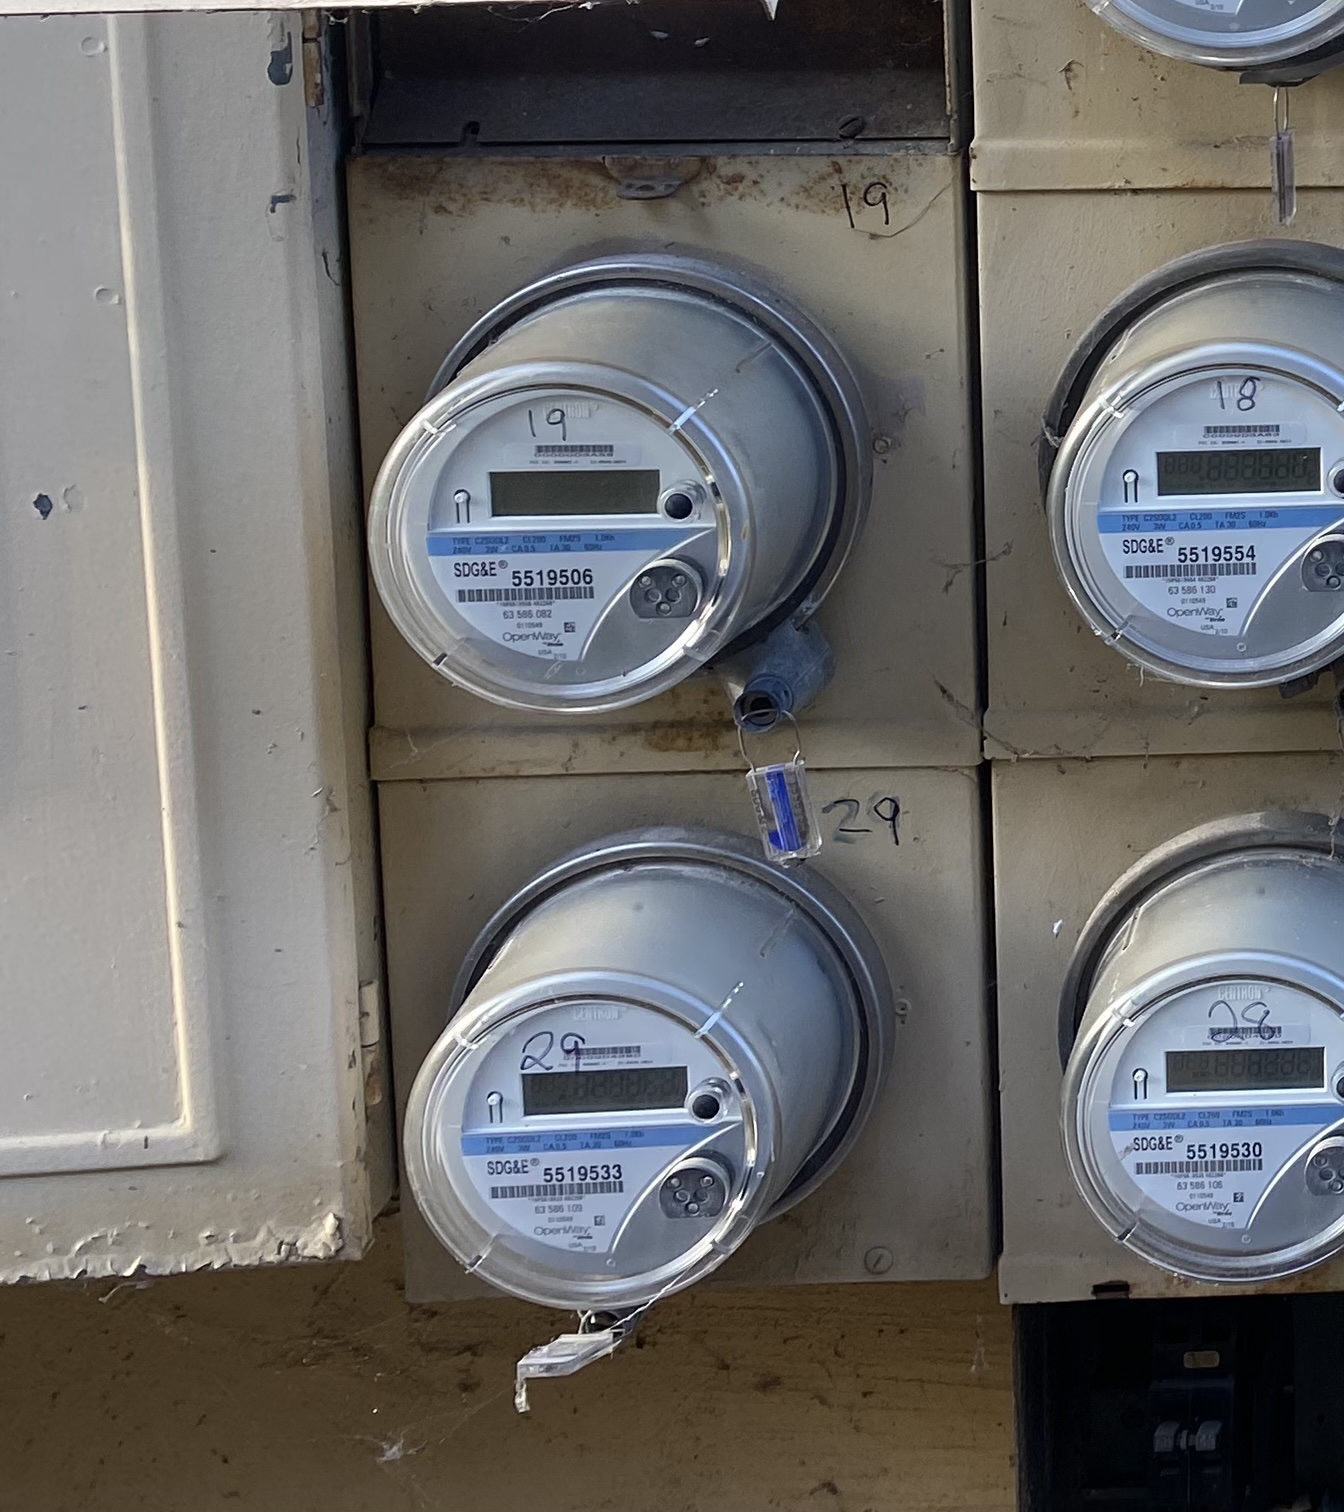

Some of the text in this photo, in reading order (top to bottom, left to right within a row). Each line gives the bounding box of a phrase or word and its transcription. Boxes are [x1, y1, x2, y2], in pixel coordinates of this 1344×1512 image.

[841, 181, 890, 229] 19
[1216, 376, 1260, 412] 18
[528, 408, 566, 442] 19
[1177, 544, 1257, 564] 5519554
[511, 568, 594, 588] 5519506
[1168, 585, 1216, 596] 63 586 130
[502, 609, 514, 620] 63
[516, 609, 534, 620] 586
[1166, 607, 1223, 618] OpenWay
[502, 632, 562, 644] OpenWay
[822, 796, 900, 846] 29
[1208, 1000, 1276, 1044] 28
[520, 1031, 586, 1073] 29
[1186, 1142, 1263, 1160] 5519530
[542, 1163, 624, 1183] 5519533
[1175, 1201, 1230, 1212] OpenWay
[533, 1225, 591, 1237] OpenWay
